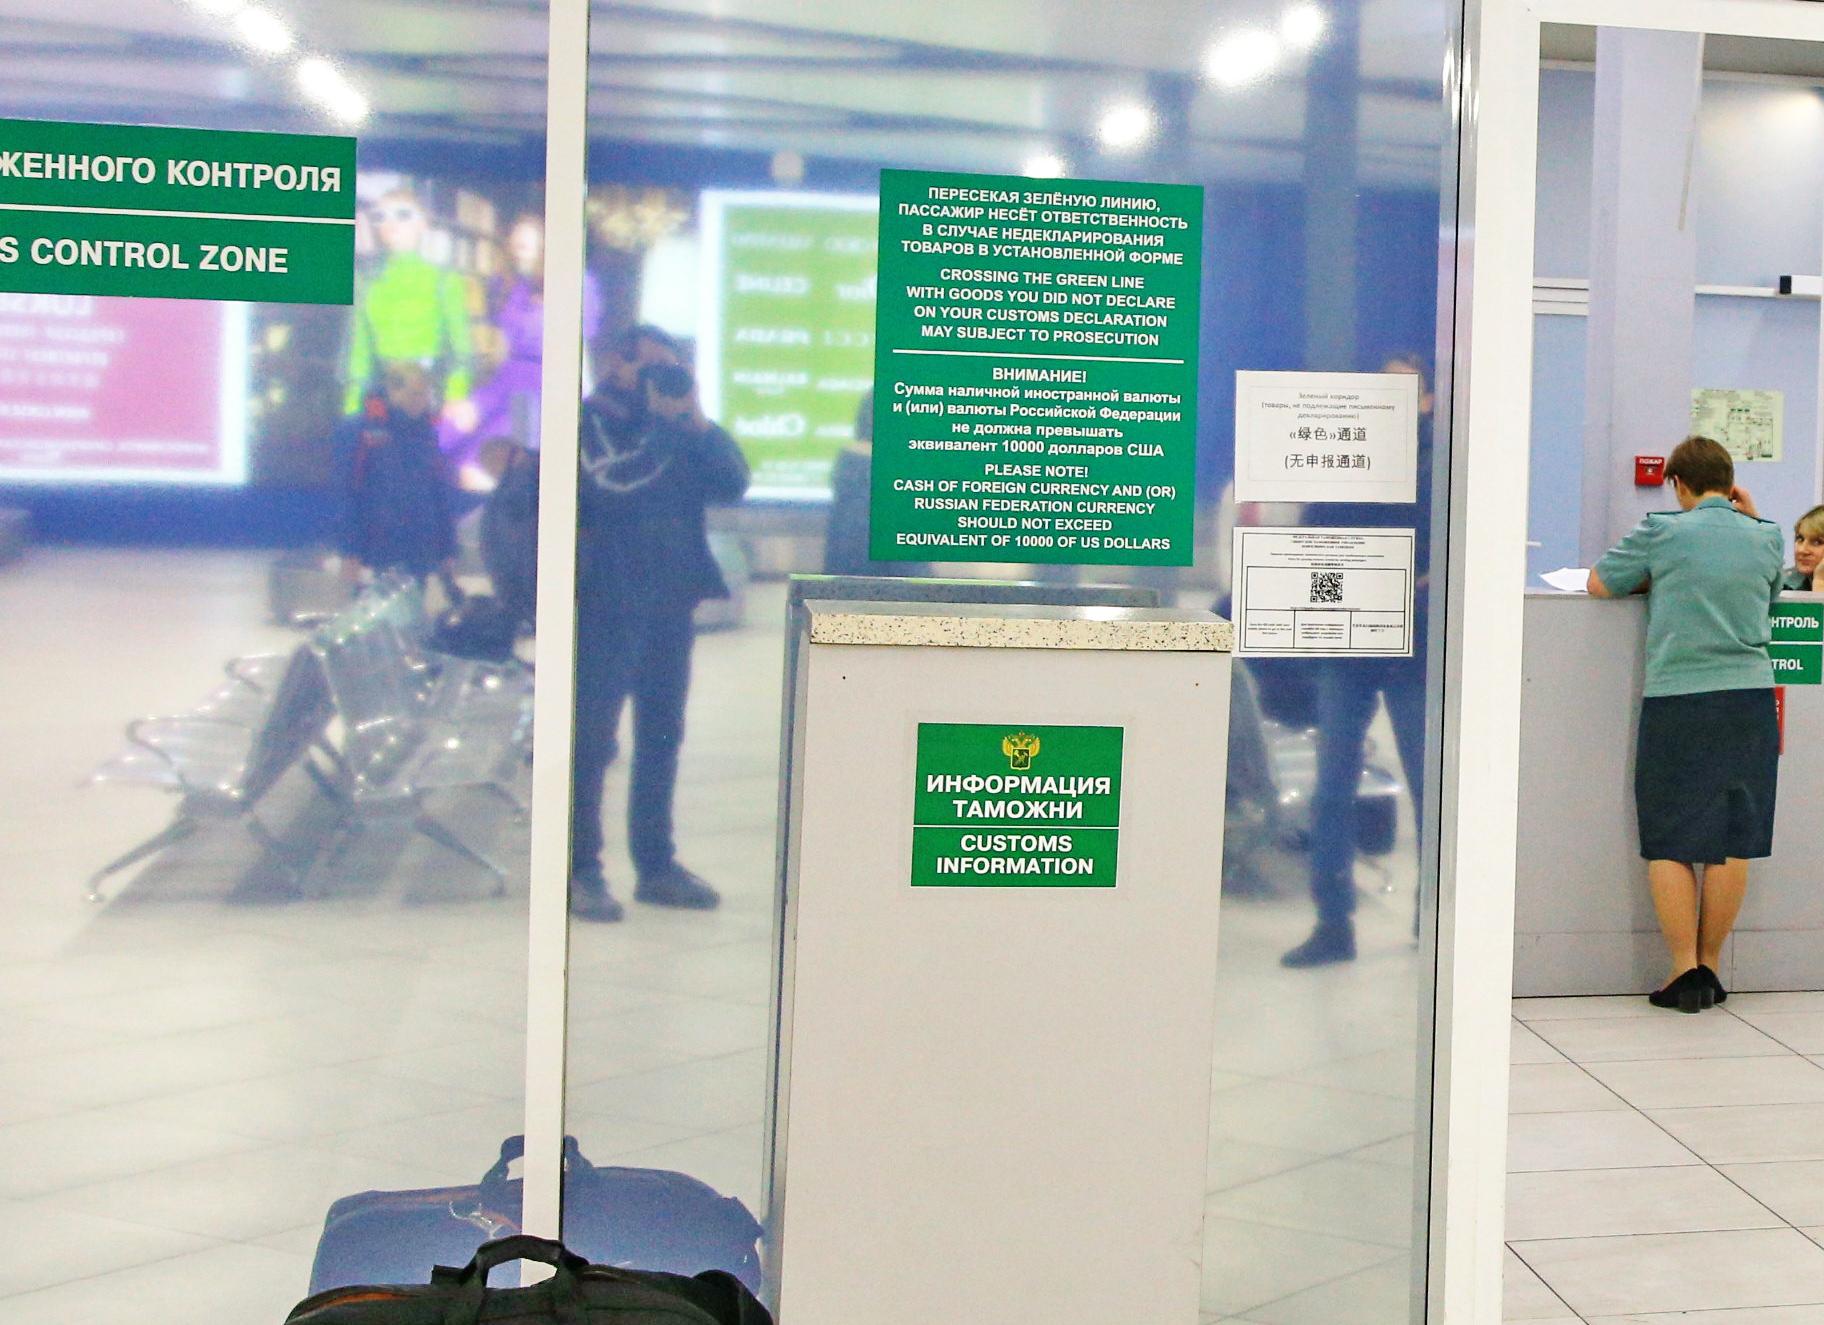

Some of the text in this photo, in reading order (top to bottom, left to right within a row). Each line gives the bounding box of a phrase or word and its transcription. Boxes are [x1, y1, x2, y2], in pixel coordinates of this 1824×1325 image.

[168, 160, 340, 191] КОНТРОЛЯ
[929, 188, 1160, 212] ПЕРЕСЕКАЯ ЗЕЛЁНУЮ ЛИНИЮ,
[899, 204, 1187, 229] ПАССАЖИР НЕСЁТ ОТВЕТСТВЕННОСТЬ
[923, 224, 1163, 246] В СЛУЧАЕ НЕДЕКЛАРИРОВАНИЯ
[31, 238, 189, 269] CONTROL
[200, 245, 287, 273] ZONE
[902, 241, 1183, 264] ТОВАРОВ В УСТАНОВЛЕННОЙ ФОРМЕ
[941, 269, 1144, 288] CROSSING THE GREEN LINE
[907, 286, 1175, 308] WITH GOODS YOU DID NOT DECLARE
[914, 306, 1167, 326] ON YOUR CUSTOMS DECLARATION
[922, 326, 1158, 345] MAY SUBJECT TO PROSECUTION
[993, 368, 1086, 382] ВНИМАНИЕ!
[895, 382, 1180, 403] Сумма наличной иностранной валюты
[893, 400, 1180, 422] и (или) валюты Российской Федерации
[952, 424, 1123, 438] не должна превышать
[909, 440, 1164, 457] эквивалент 10000 долларов США
[985, 464, 1088, 477] PLEASE NOTE!
[894, 480, 1175, 499] CASH OF FOREIGN CURRENCY AND (OR)
[915, 498, 1155, 514] RUSSIAN FEDERATION CURRENCY
[958, 517, 1111, 530] SHOULD NOT EXCEED
[897, 534, 1170, 549] EQUIVALENT OF 10000 OF US DOLLARS
[927, 775, 1110, 797] ИНФОРМАЦИЯ
[953, 800, 1082, 818] ТАМОЖНИ
[961, 835, 1072, 852] CUSTOMS
[937, 857, 1093, 874] INFORMATION
